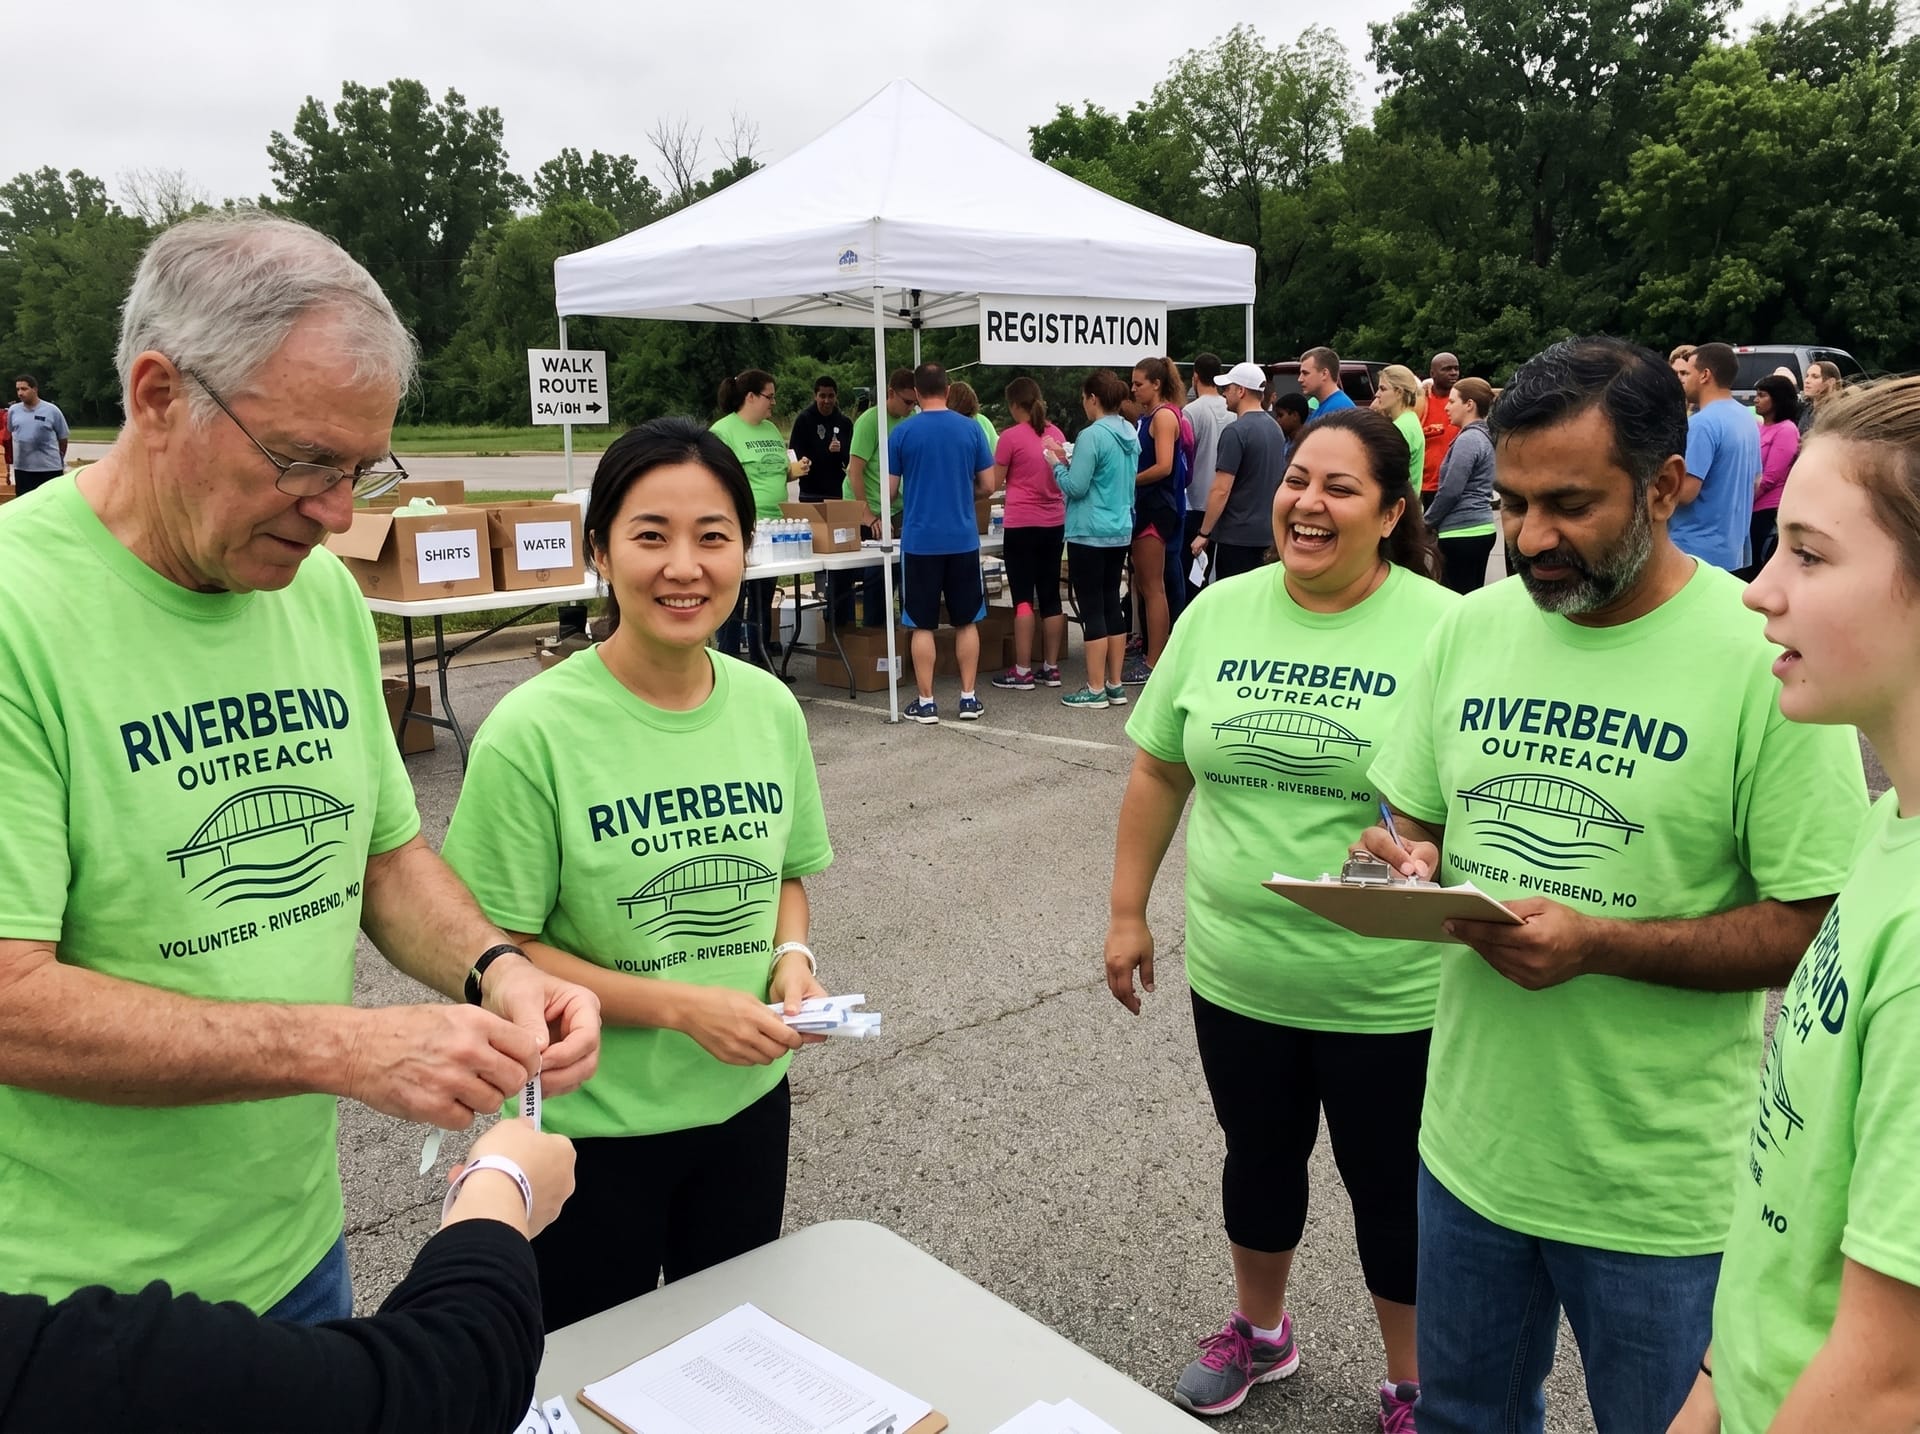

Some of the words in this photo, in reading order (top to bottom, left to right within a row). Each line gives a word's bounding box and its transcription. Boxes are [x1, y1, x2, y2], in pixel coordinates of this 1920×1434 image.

[987, 310, 1159, 346] REGISTRATION
[541, 357, 593, 373] WALK
[539, 378, 598, 393] ROUTE
[425, 547, 471, 562] SHIRTS
[523, 538, 566, 551] WATER
[1216, 659, 1397, 697] RIVERBEND
[1237, 686, 1362, 711] OUTREACH
[119, 688, 350, 773] RIVERBEND
[1459, 697, 1688, 762] RIVERBEND
[177, 738, 333, 791] OUTREACH
[1481, 737, 1636, 779] OUTREACH
[1204, 771, 1268, 789] VOLUNTEER
[1277, 780, 1347, 801] RIVERBEND,
[1351, 791, 1371, 802] MO
[588, 781, 783, 843] RIVERBEND
[630, 820, 769, 857] OUTREACH
[1448, 852, 1509, 884] VOLUNTEER
[1519, 873, 1607, 907] RIVERBEND,
[1612, 892, 1637, 908] MO
[158, 921, 259, 960] VOLUNTEER
[268, 892, 344, 932] RIVERBEND,
[345, 881, 360, 901] MO
[614, 950, 687, 973] VOLUNTEER
[1761, 1204, 1788, 1234] MO
